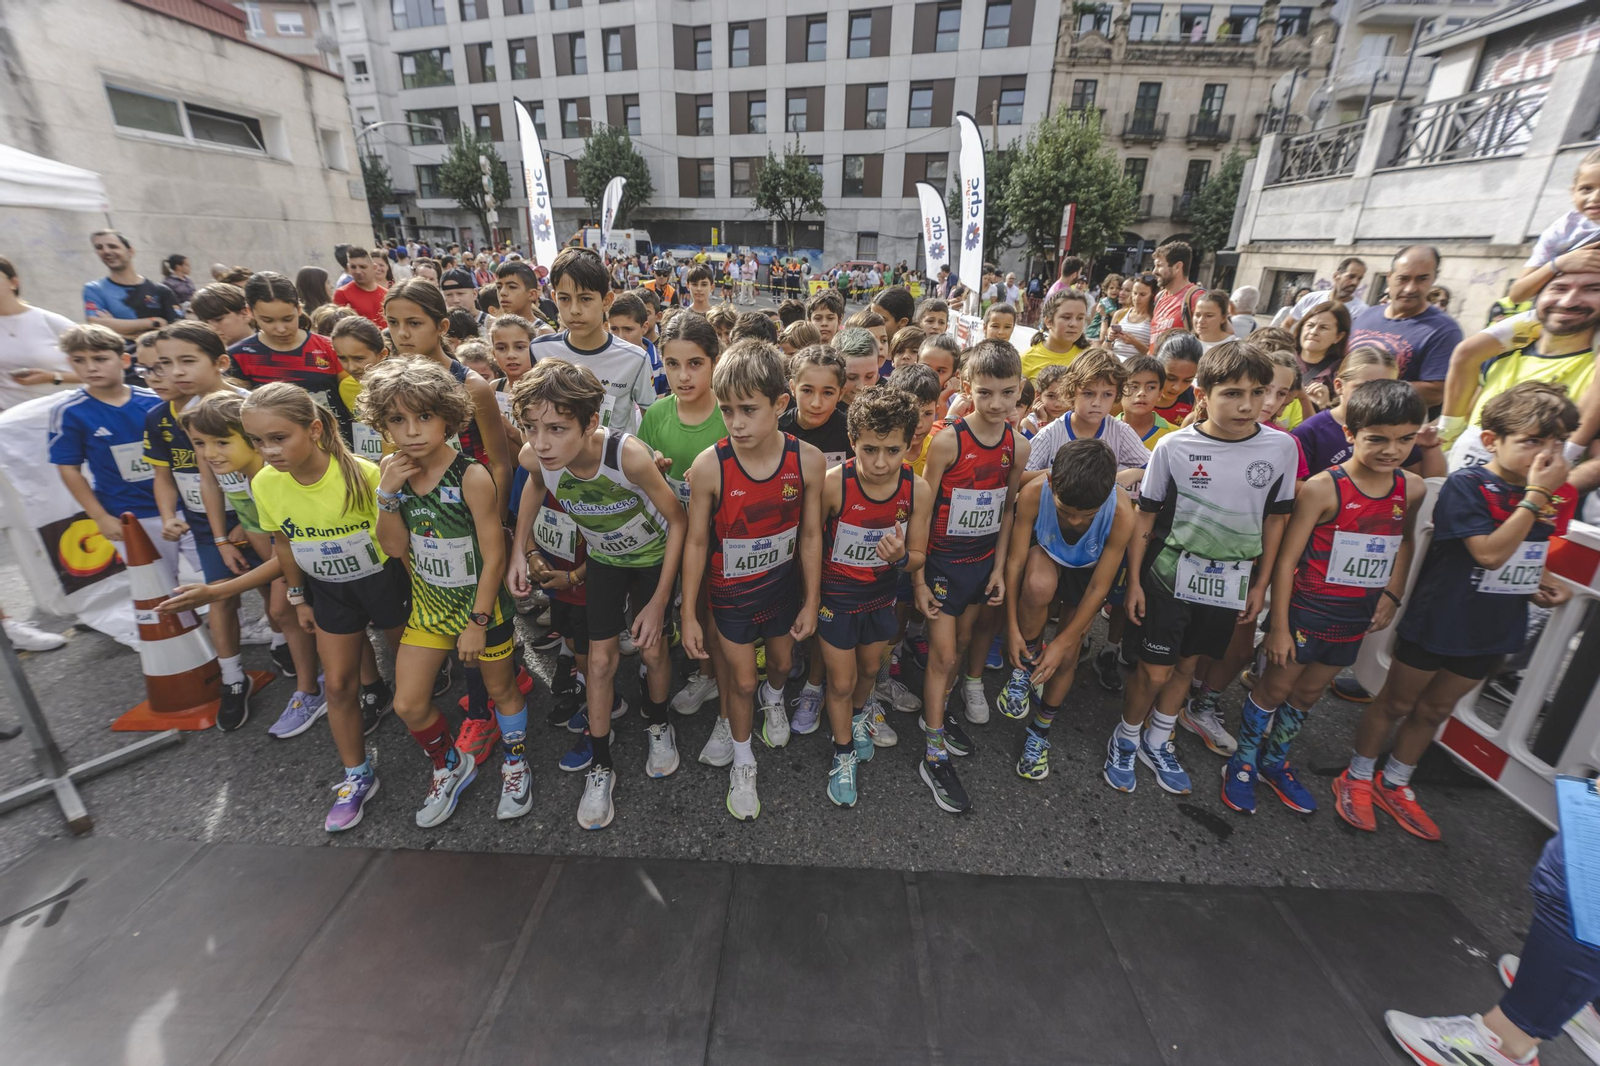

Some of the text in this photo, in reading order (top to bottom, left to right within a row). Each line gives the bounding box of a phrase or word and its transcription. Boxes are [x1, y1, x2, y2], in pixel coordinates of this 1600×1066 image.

[361, 439, 383, 453] 400
[131, 459, 152, 473] 45
[958, 509, 994, 528] 4023
[305, 520, 371, 537] Running
[537, 524, 563, 549] 4047
[600, 535, 638, 551] 4013
[844, 544, 879, 561] 402
[313, 555, 361, 576] 4209
[416, 553, 451, 577] 4401
[735, 549, 779, 570] 4020
[1342, 557, 1388, 579] 4027
[1187, 575, 1225, 598] 4019
[482, 646, 511, 657] ucus
